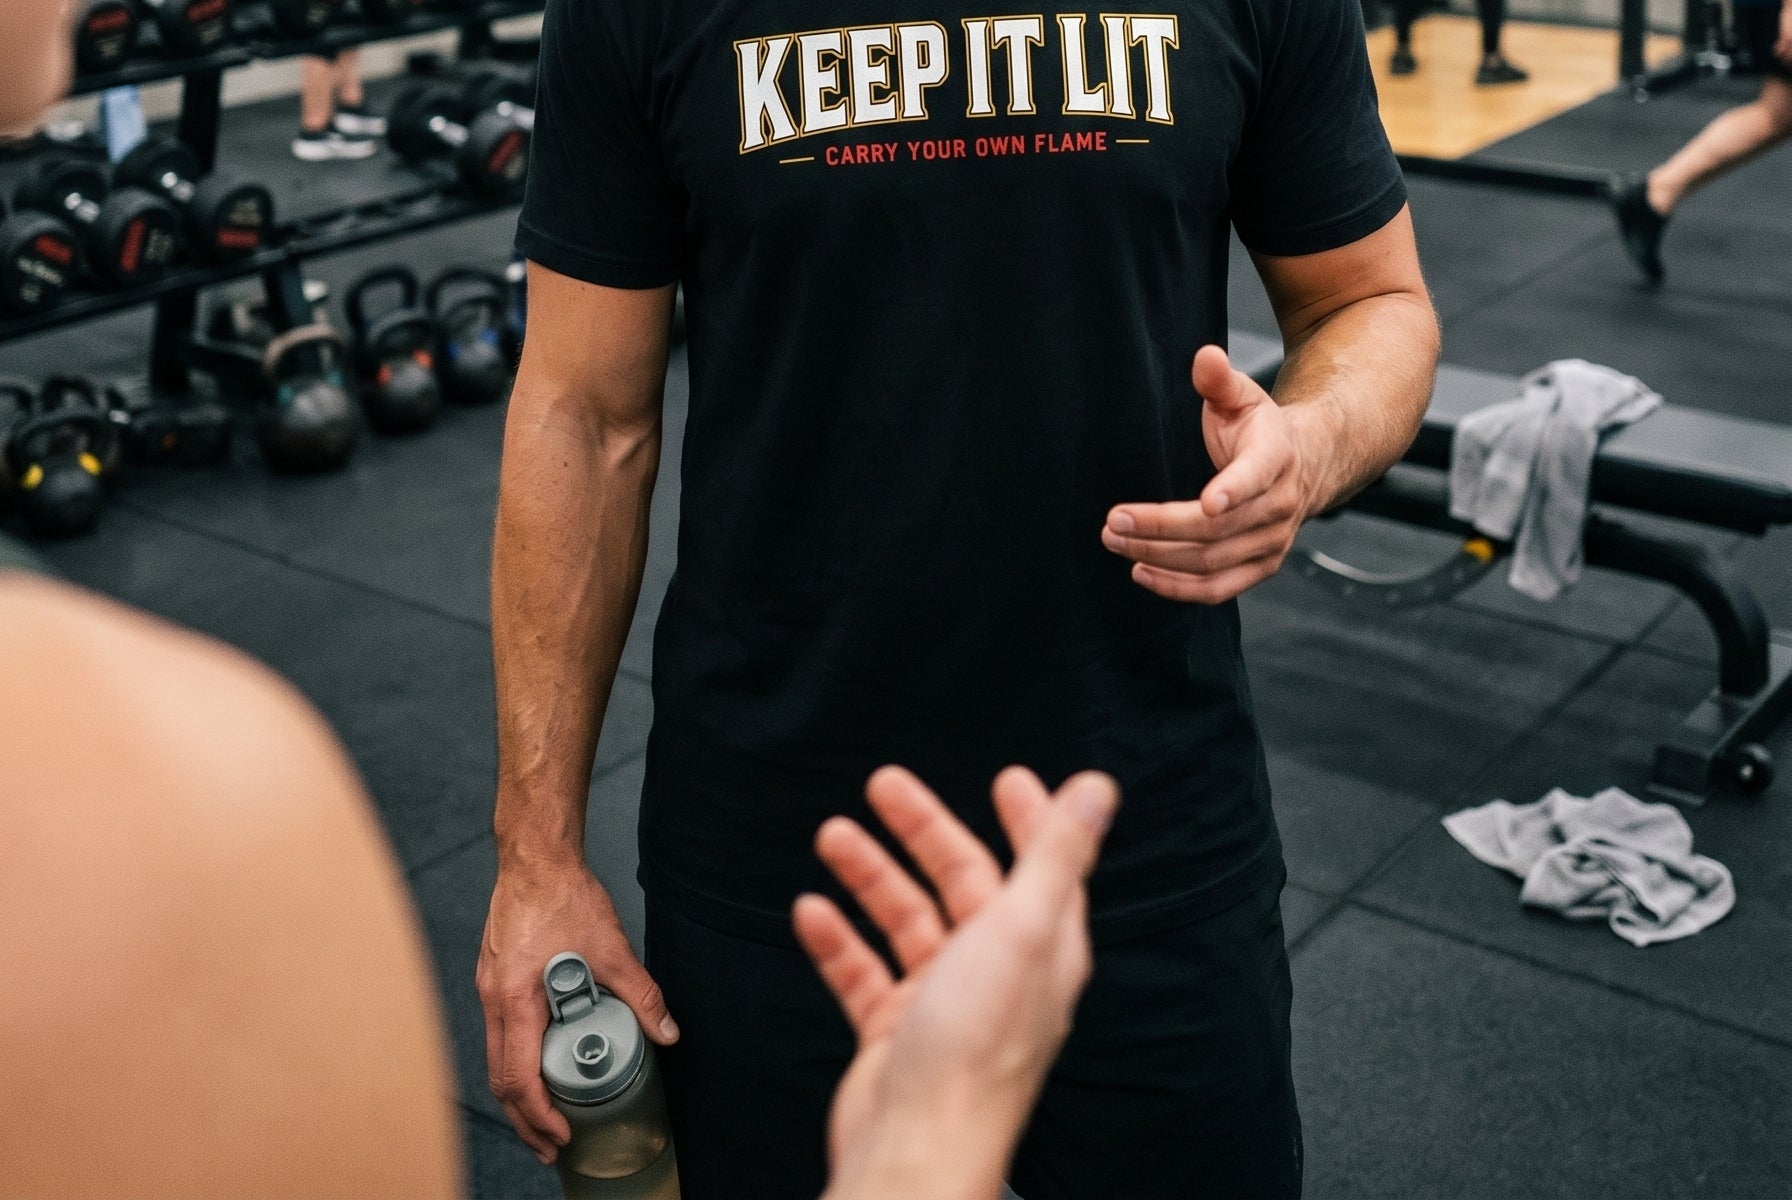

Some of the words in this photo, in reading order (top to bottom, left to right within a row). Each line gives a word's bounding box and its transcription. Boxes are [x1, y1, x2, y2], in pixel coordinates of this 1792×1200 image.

[733, 20, 949, 155] KEEP
[961, 14, 1044, 118] IT
[1056, 13, 1180, 125] LIT
[825, 142, 898, 166] CARRY
[908, 139, 966, 161] YOUR
[975, 135, 1025, 157] OWN
[1035, 131, 1107, 153] FLAME
